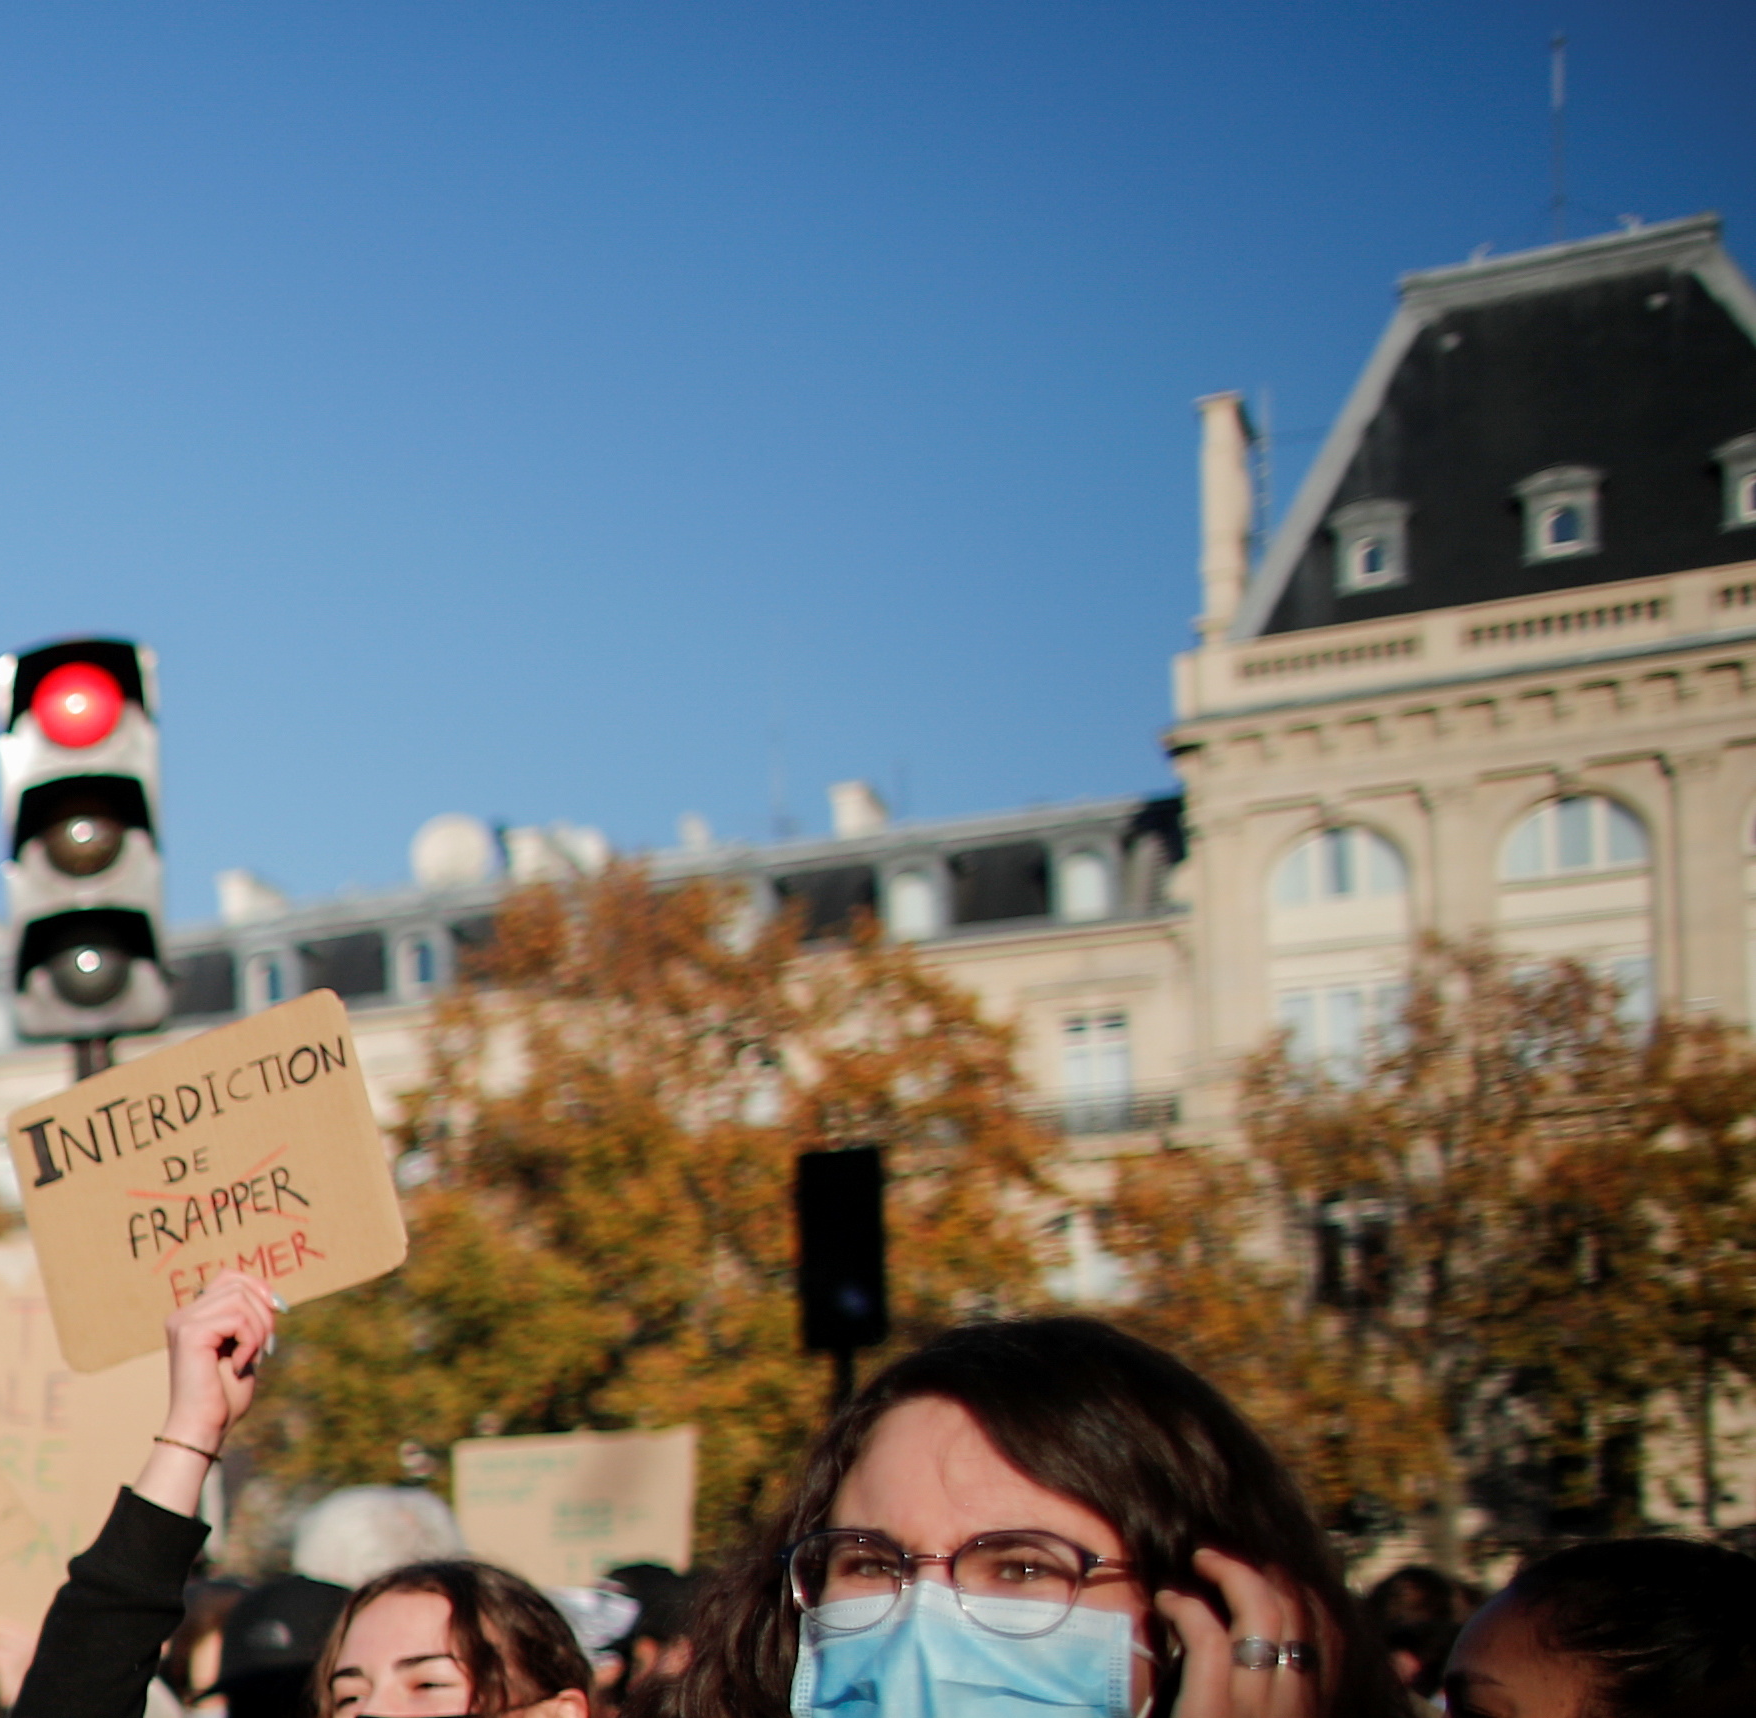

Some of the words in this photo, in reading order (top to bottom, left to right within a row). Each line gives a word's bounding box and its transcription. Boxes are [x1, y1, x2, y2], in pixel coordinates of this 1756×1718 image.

[19, 1036, 347, 1188] INTERDICTION
[162, 1147, 210, 1185] DE
[128, 1166, 311, 1260] FRAPPER
[170, 1230, 326, 1308] FIMER
